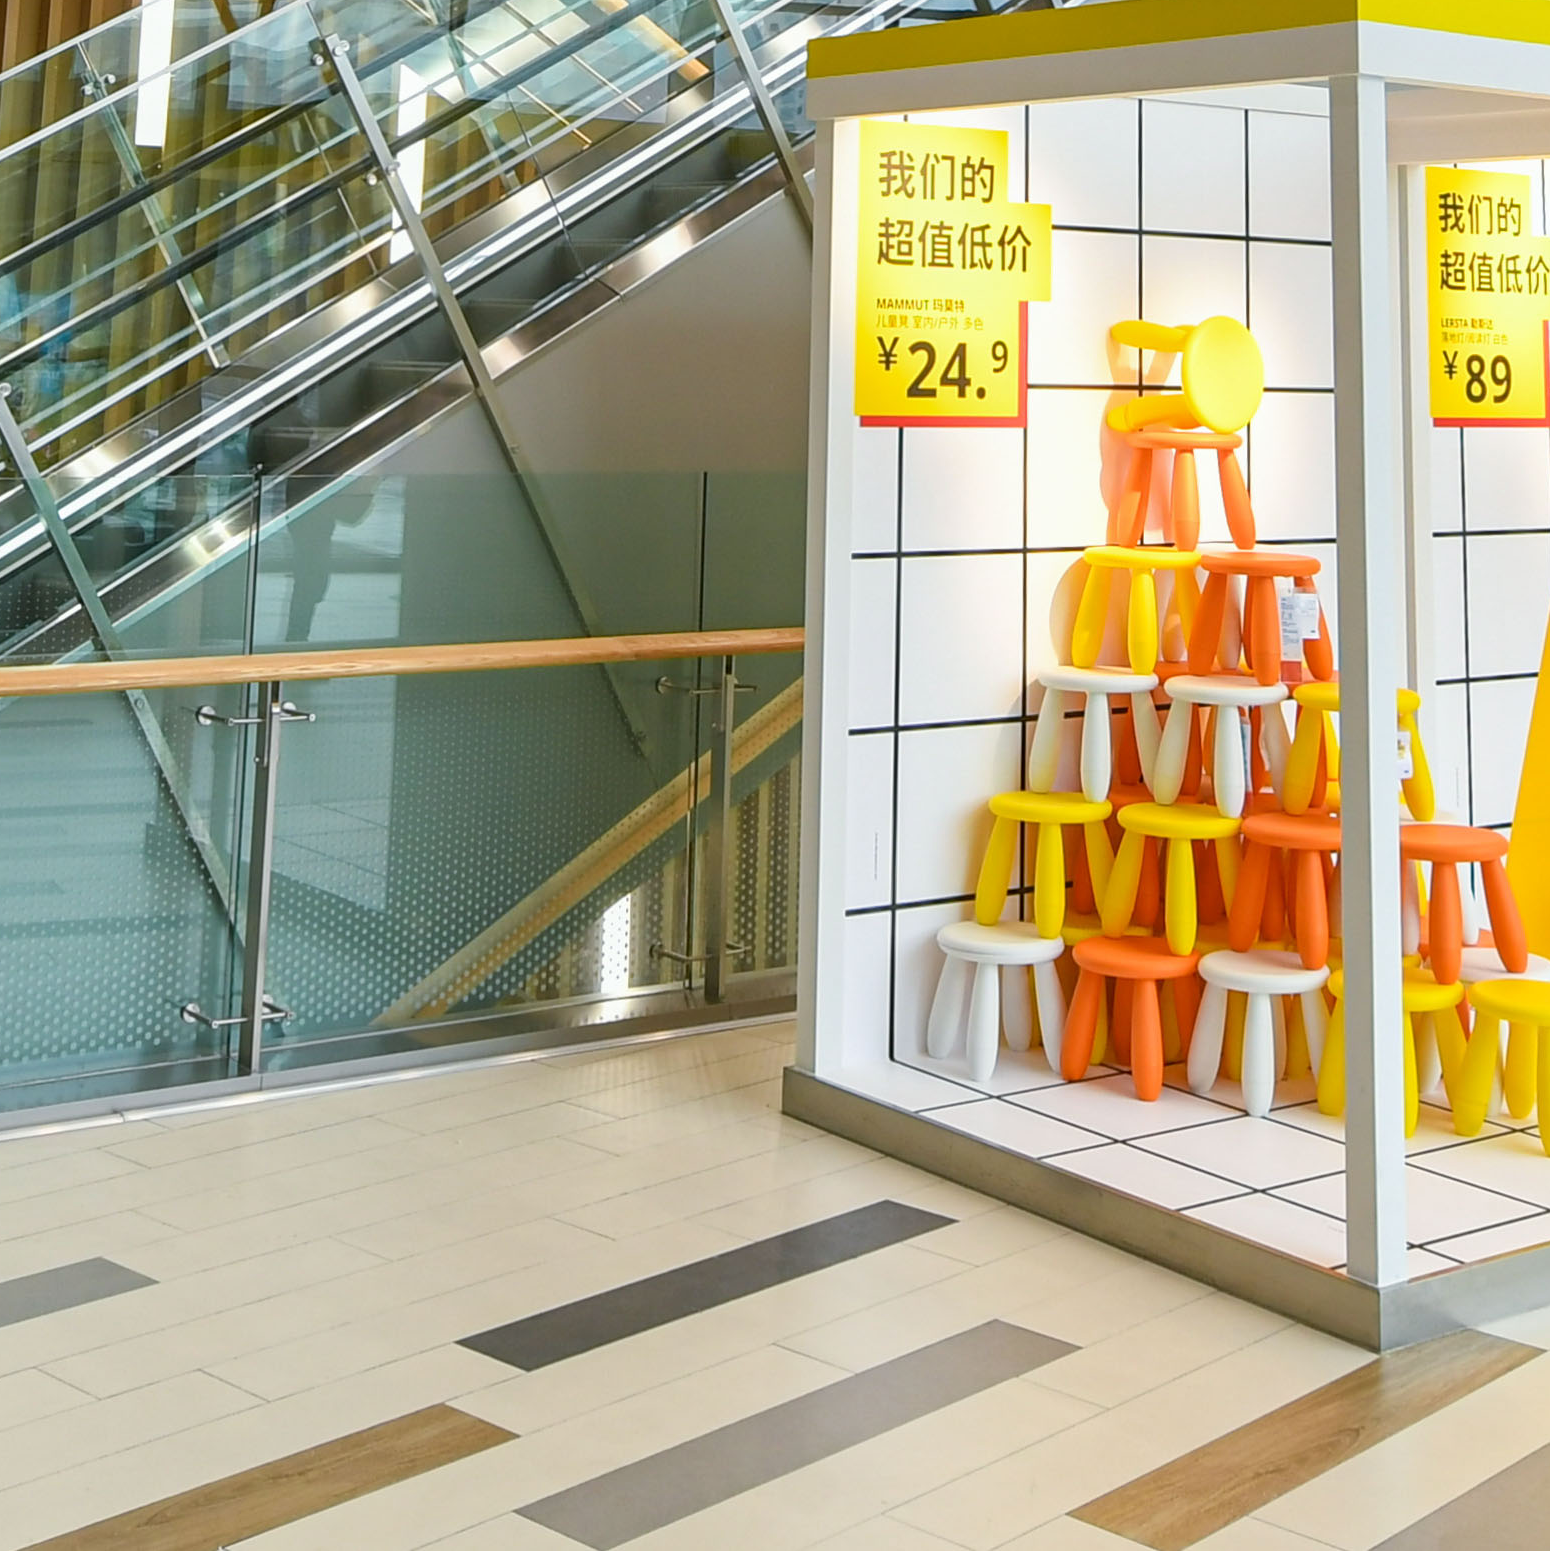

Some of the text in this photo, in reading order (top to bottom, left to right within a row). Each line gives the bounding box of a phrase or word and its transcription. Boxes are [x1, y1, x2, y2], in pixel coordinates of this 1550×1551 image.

[878, 149, 995, 203] 我们的
[1438, 192, 1522, 237] 我们的
[877, 216, 1031, 273] 超值低价
[1440, 249, 1549, 296] 超值低价
[876, 298, 929, 311] MAMMUT
